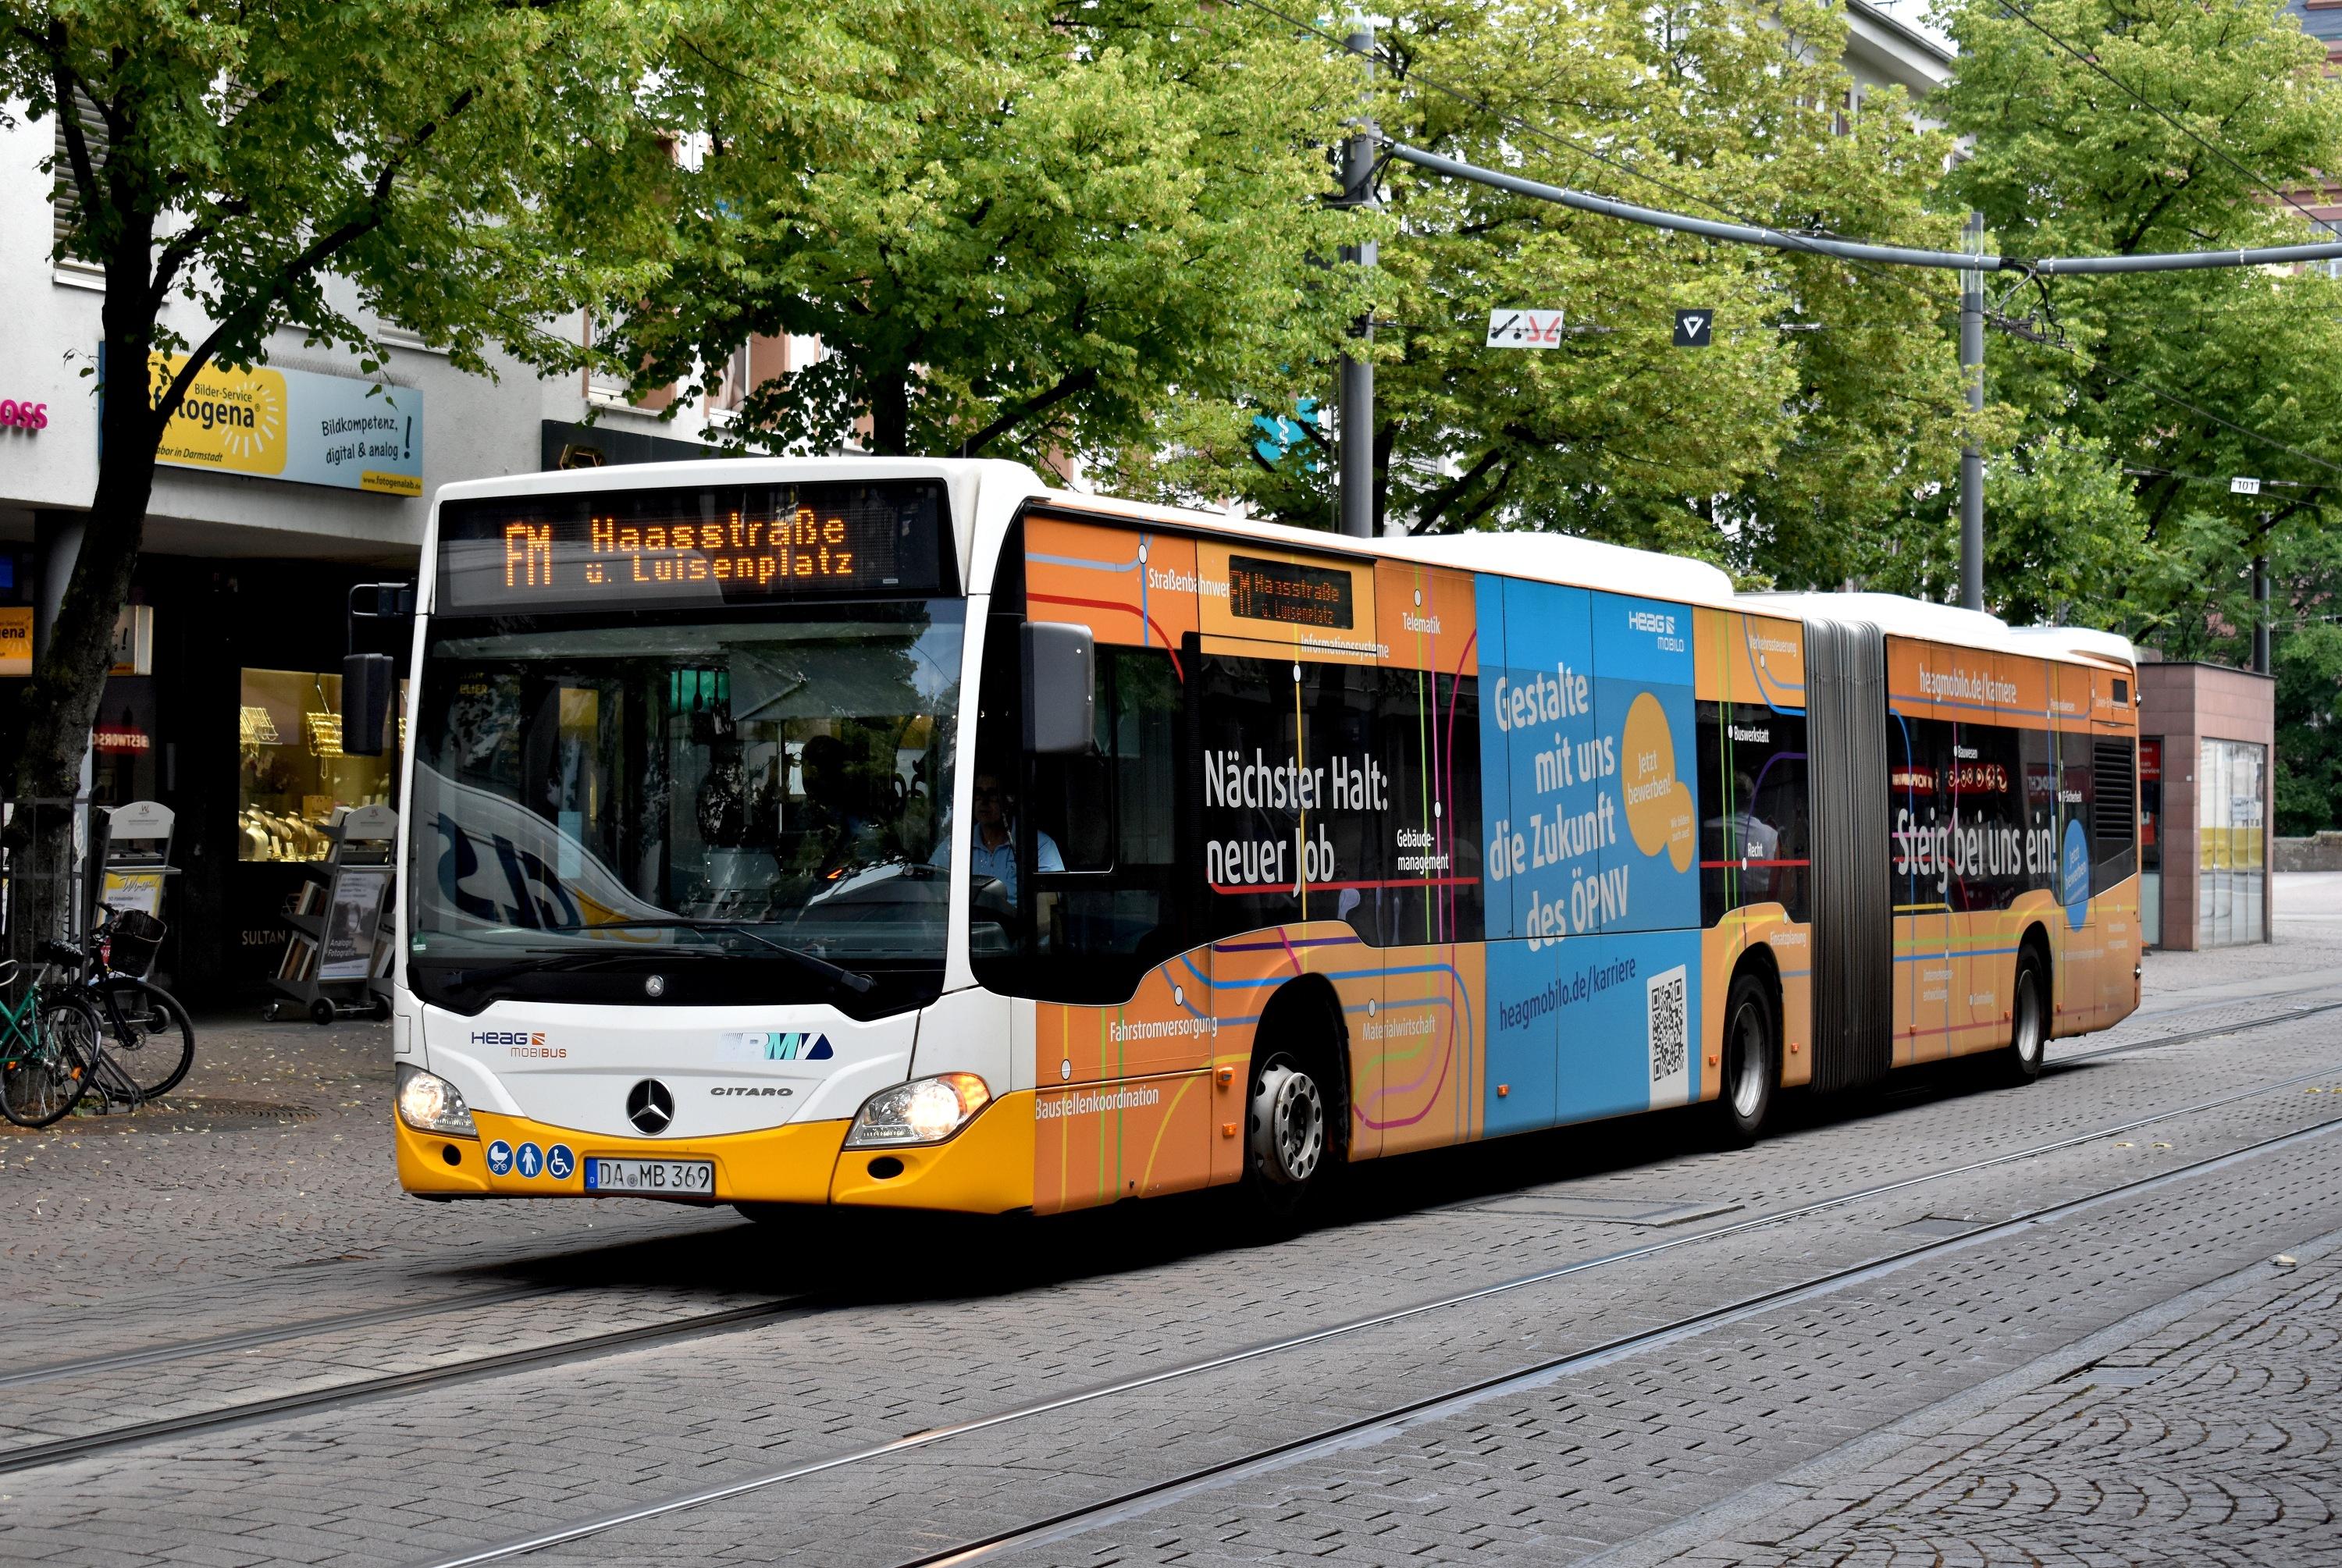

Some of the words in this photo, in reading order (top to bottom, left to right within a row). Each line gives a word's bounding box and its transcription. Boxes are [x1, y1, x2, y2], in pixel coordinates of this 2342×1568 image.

[194, 383, 253, 403] Bilder-Service
[322, 415, 398, 436] Bildkompetenz,
[155, 446, 174, 456] abor
[175, 448, 182, 457] in
[183, 448, 223, 463] Darmstadt
[326, 443, 355, 466] digital
[358, 442, 366, 458] &
[369, 441, 398, 461] analog
[363, 475, 422, 490] www.fotogenalab.de
[2237, 481, 2255, 492] 101
[507, 525, 551, 587] FM
[593, 508, 845, 553] Haasstraße
[586, 560, 613, 584] ü.
[634, 546, 854, 584] Luisenplatz
[1230, 570, 1251, 615] FM
[1403, 612, 1441, 635] Telematik
[1301, 633, 1389, 660] Informationssysteme
[1657, 636, 1684, 652] MOBILO
[1749, 635, 1796, 658] Verkehrssteuerung
[1920, 663, 2016, 705] heagmobilo.de/karriere
[1495, 662, 1589, 732] Gestalte
[1734, 726, 1769, 744] Buswerkstatt
[1535, 732, 1573, 795] mit
[1577, 735, 1615, 783] uns
[1638, 749, 1658, 780] Jetzt
[1958, 745, 1977, 759] Bauwesen
[1205, 748, 1324, 809] Nächster
[1333, 754, 1388, 810] Halt:
[1628, 773, 1671, 805] bewerben!
[1397, 829, 1435, 848] Gebäude-
[1490, 820, 1525, 882] die
[1530, 791, 1616, 869] Zukunft
[1208, 838, 1287, 884] neuer
[1293, 824, 1335, 898] Job
[1397, 852, 1449, 873] management
[1747, 843, 1763, 858] Recht
[1897, 807, 1949, 894] Steig
[1955, 808, 1984, 875] bei
[1989, 828, 2020, 875] uns
[2026, 812, 2057, 874] ein!
[1526, 891, 1567, 952] des
[1571, 865, 1629, 933] ÖPNV
[242, 930, 286, 945] SULTAN
[1500, 957, 1636, 1031] heagmobilo.de/karriere
[1110, 1016, 1217, 1042] Fahrstromversorgung
[1362, 1017, 1436, 1040] Materialwirtschaft
[511, 1047, 567, 1058] MOBIBUS
[711, 1087, 793, 1096] CITARO
[1035, 1087, 1159, 1119] Baustellenkoordination
[600, 1162, 624, 1186] DA
[639, 1164, 665, 1187] MB
[672, 1165, 710, 1189] 369
